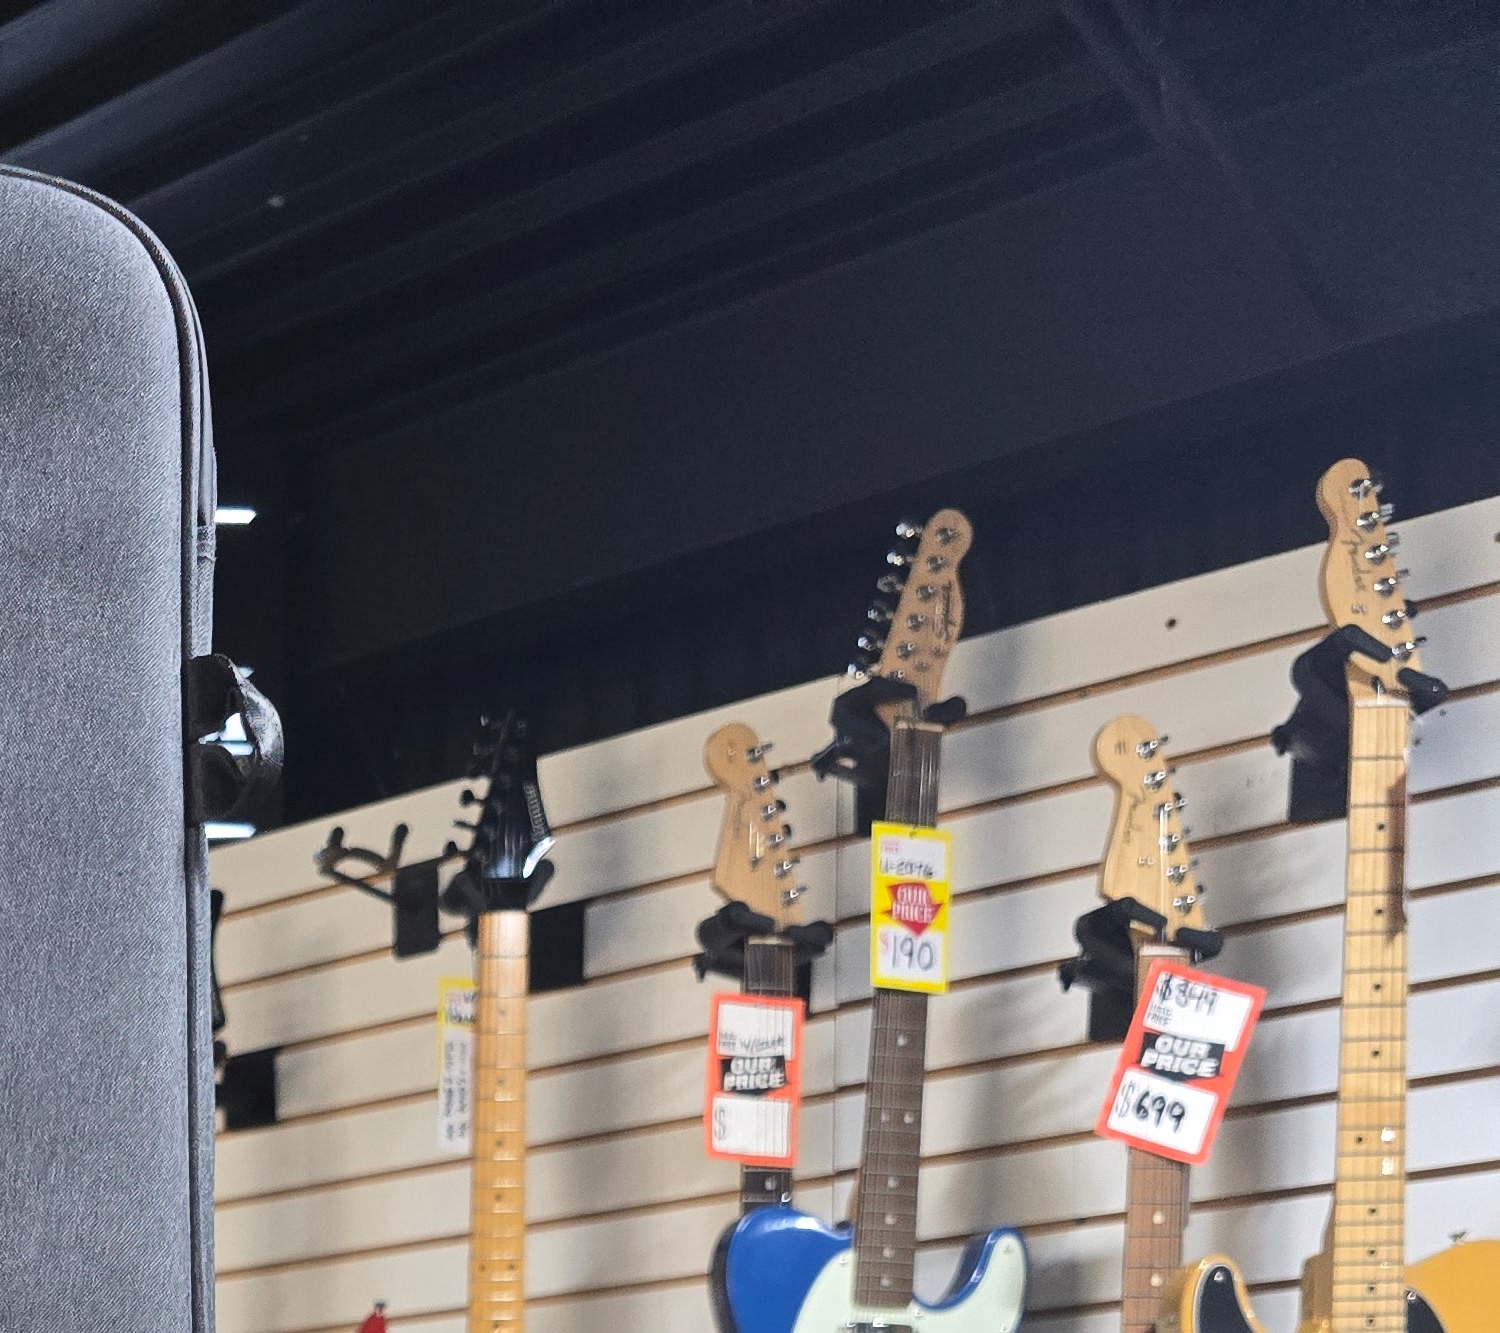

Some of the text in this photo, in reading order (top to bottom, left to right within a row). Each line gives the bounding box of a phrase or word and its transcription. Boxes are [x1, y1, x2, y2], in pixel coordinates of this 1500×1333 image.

[1154, 1033, 1211, 1059] OUR
[730, 1056, 776, 1076] OUR
[1140, 1048, 1219, 1078] PRICE
[723, 1071, 786, 1092] PRICE
[1115, 1080, 1186, 1134] $699
